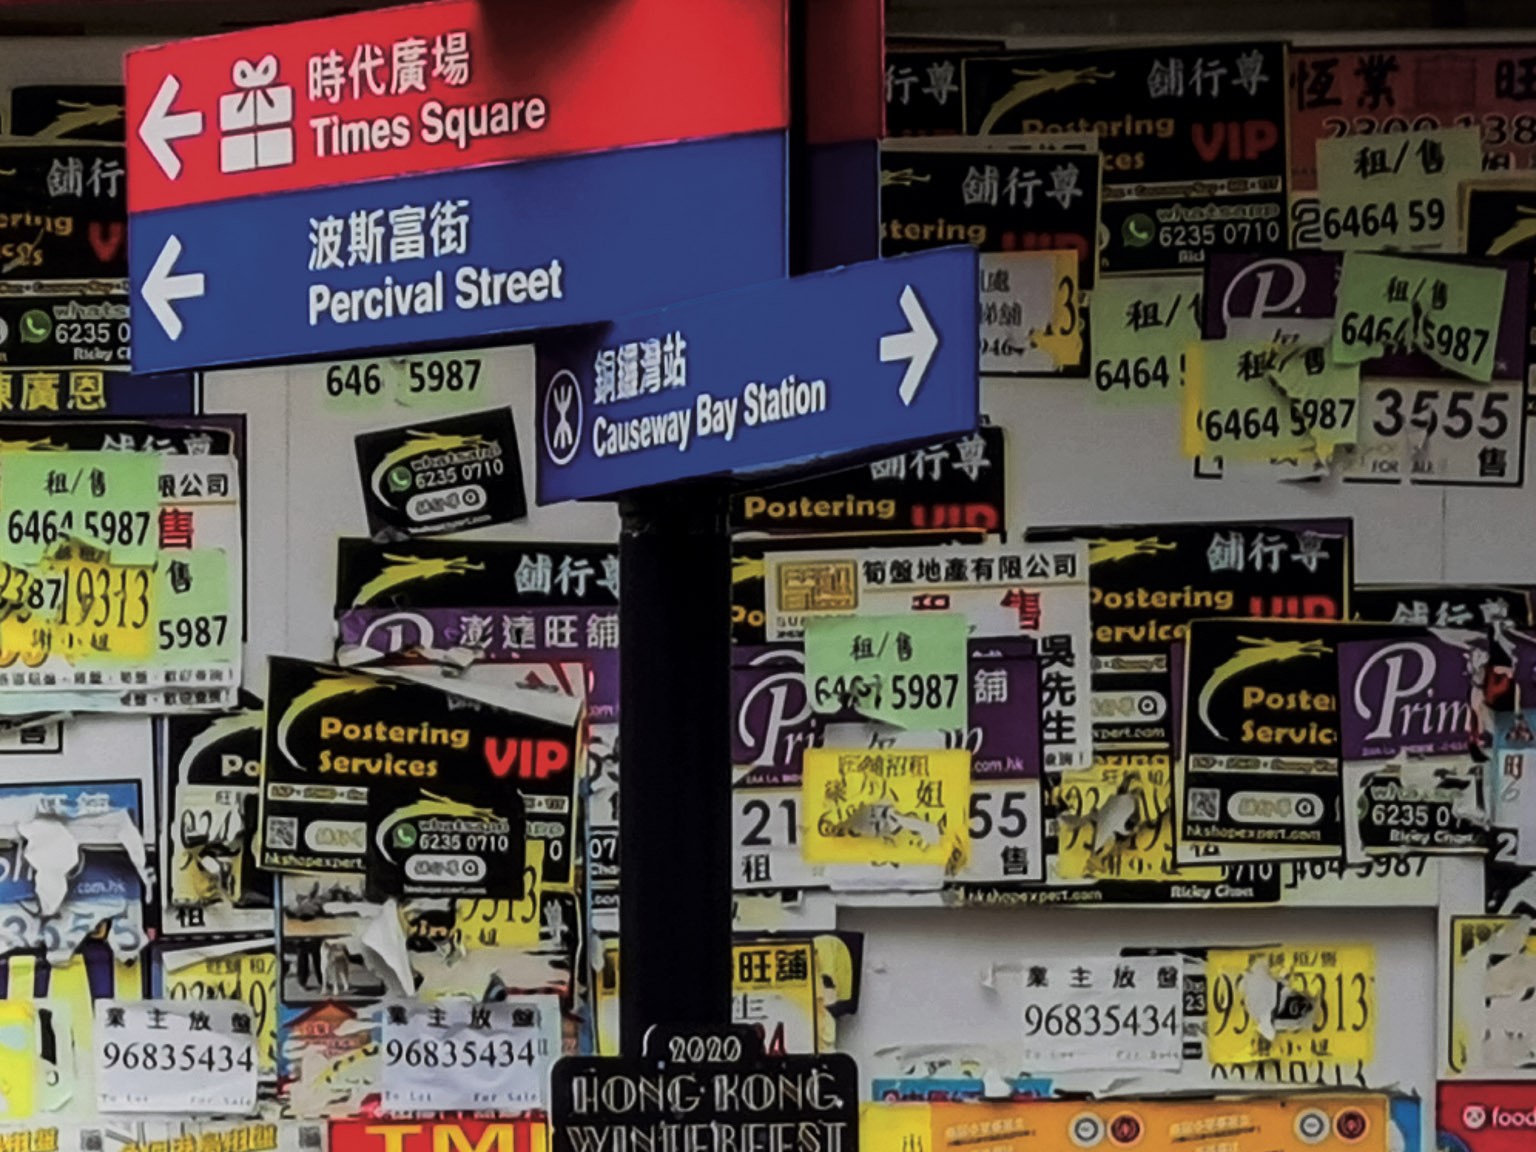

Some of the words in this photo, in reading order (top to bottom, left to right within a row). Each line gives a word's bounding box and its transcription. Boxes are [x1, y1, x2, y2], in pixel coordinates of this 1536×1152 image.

[308, 32, 469, 102] 時代廣場
[310, 115, 410, 156] Times
[421, 98, 546, 148] Square
[1191, 119, 1279, 163] VIP
[308, 200, 469, 271] 波斯富街
[1159, 223, 1216, 247] 6235
[1222, 222, 1280, 244] 0710
[309, 269, 442, 326] Percival
[455, 260, 563, 310] Street
[1096, 356, 1169, 391] 6464
[593, 407, 690, 458] Causeway
[696, 395, 738, 442] Bay
[743, 375, 826, 426] Station
[1205, 408, 1279, 441] 6464
[415, 469, 457, 489] 6235
[463, 460, 504, 480] 0710
[744, 495, 896, 519] Postering
[85, 512, 151, 546] 5987
[159, 616, 228, 649] 5987
[891, 673, 958, 710] 5987
[320, 717, 470, 749] Postering
[319, 750, 437, 777] Services
[484, 737, 568, 779] VIP
[1372, 804, 1425, 826] 6235
[419, 835, 461, 850] 6235
[467, 836, 508, 851] 0710
[1025, 1003, 1177, 1036] 96835434
[104, 1042, 253, 1071] 96835434
[386, 1039, 535, 1066] 96835434
[669, 1036, 741, 1063] 2020
[572, 1075, 700, 1114] HONG
[715, 1074, 843, 1114] KONG
